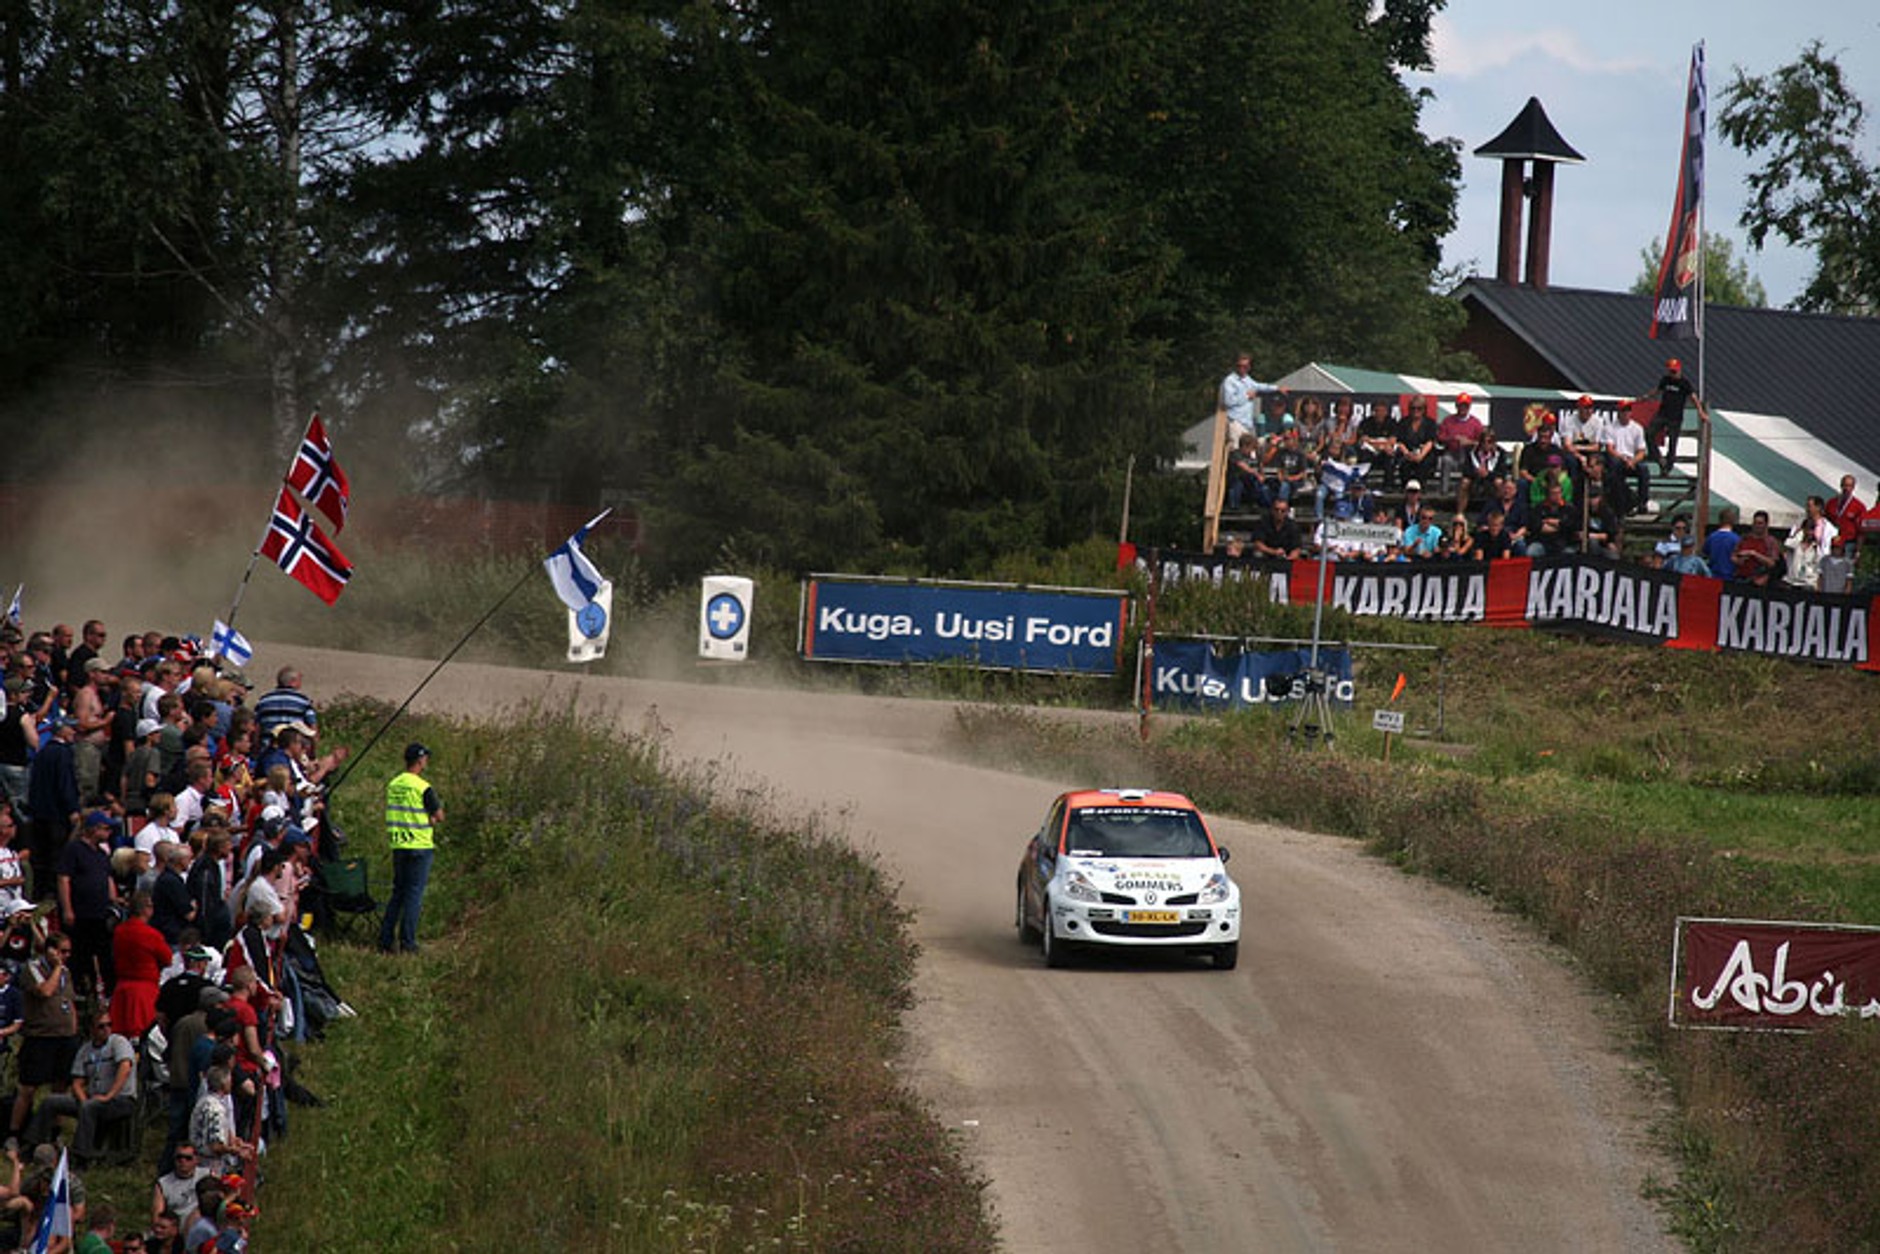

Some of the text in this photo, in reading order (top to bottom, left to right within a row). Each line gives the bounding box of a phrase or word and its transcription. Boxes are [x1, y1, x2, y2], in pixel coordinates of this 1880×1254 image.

[819, 605, 1113, 647] Kuga. Uusi Ford
[1333, 573, 1485, 621] KARJALA
[1525, 566, 1678, 638] KARJALA
[1718, 594, 1868, 662] KARJALA
